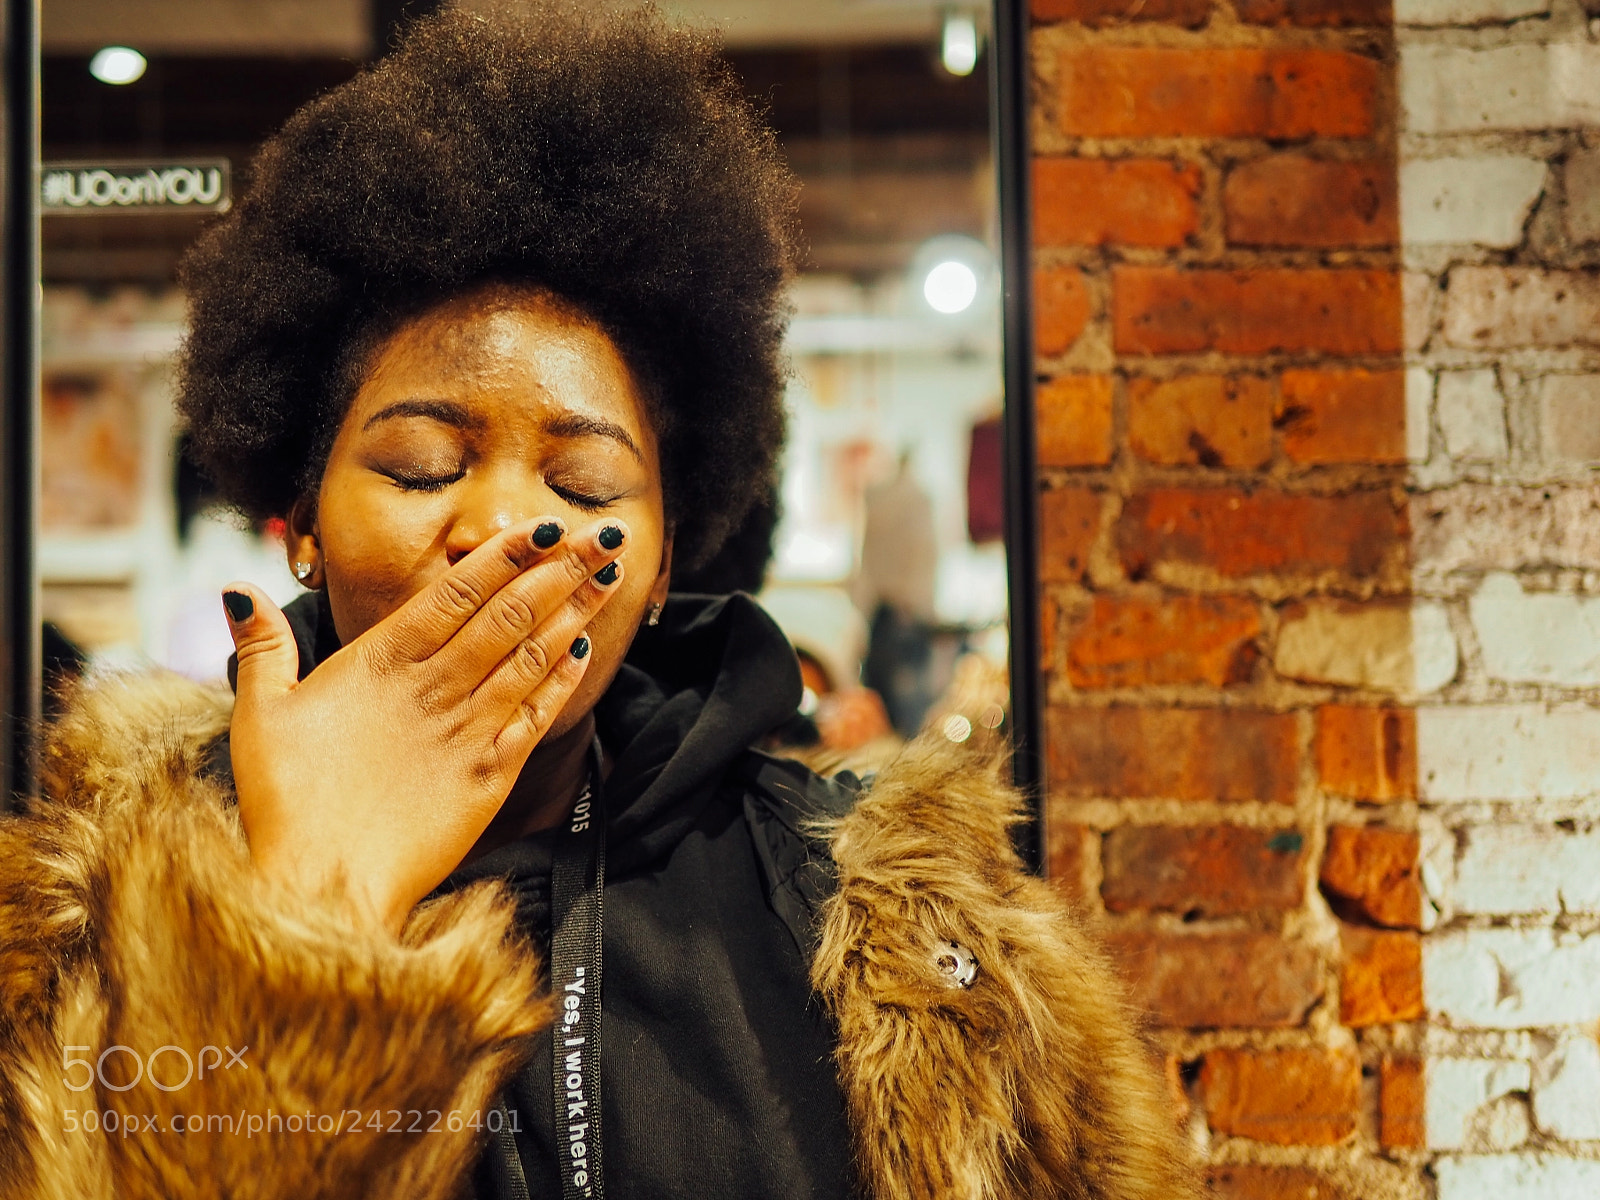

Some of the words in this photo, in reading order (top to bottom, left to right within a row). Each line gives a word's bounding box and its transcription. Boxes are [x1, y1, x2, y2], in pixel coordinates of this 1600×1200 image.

[562, 966, 586, 1033] "Yes,
[564, 1037, 586, 1047] I
[565, 1050, 588, 1120] work
[569, 1122, 592, 1198] here"
